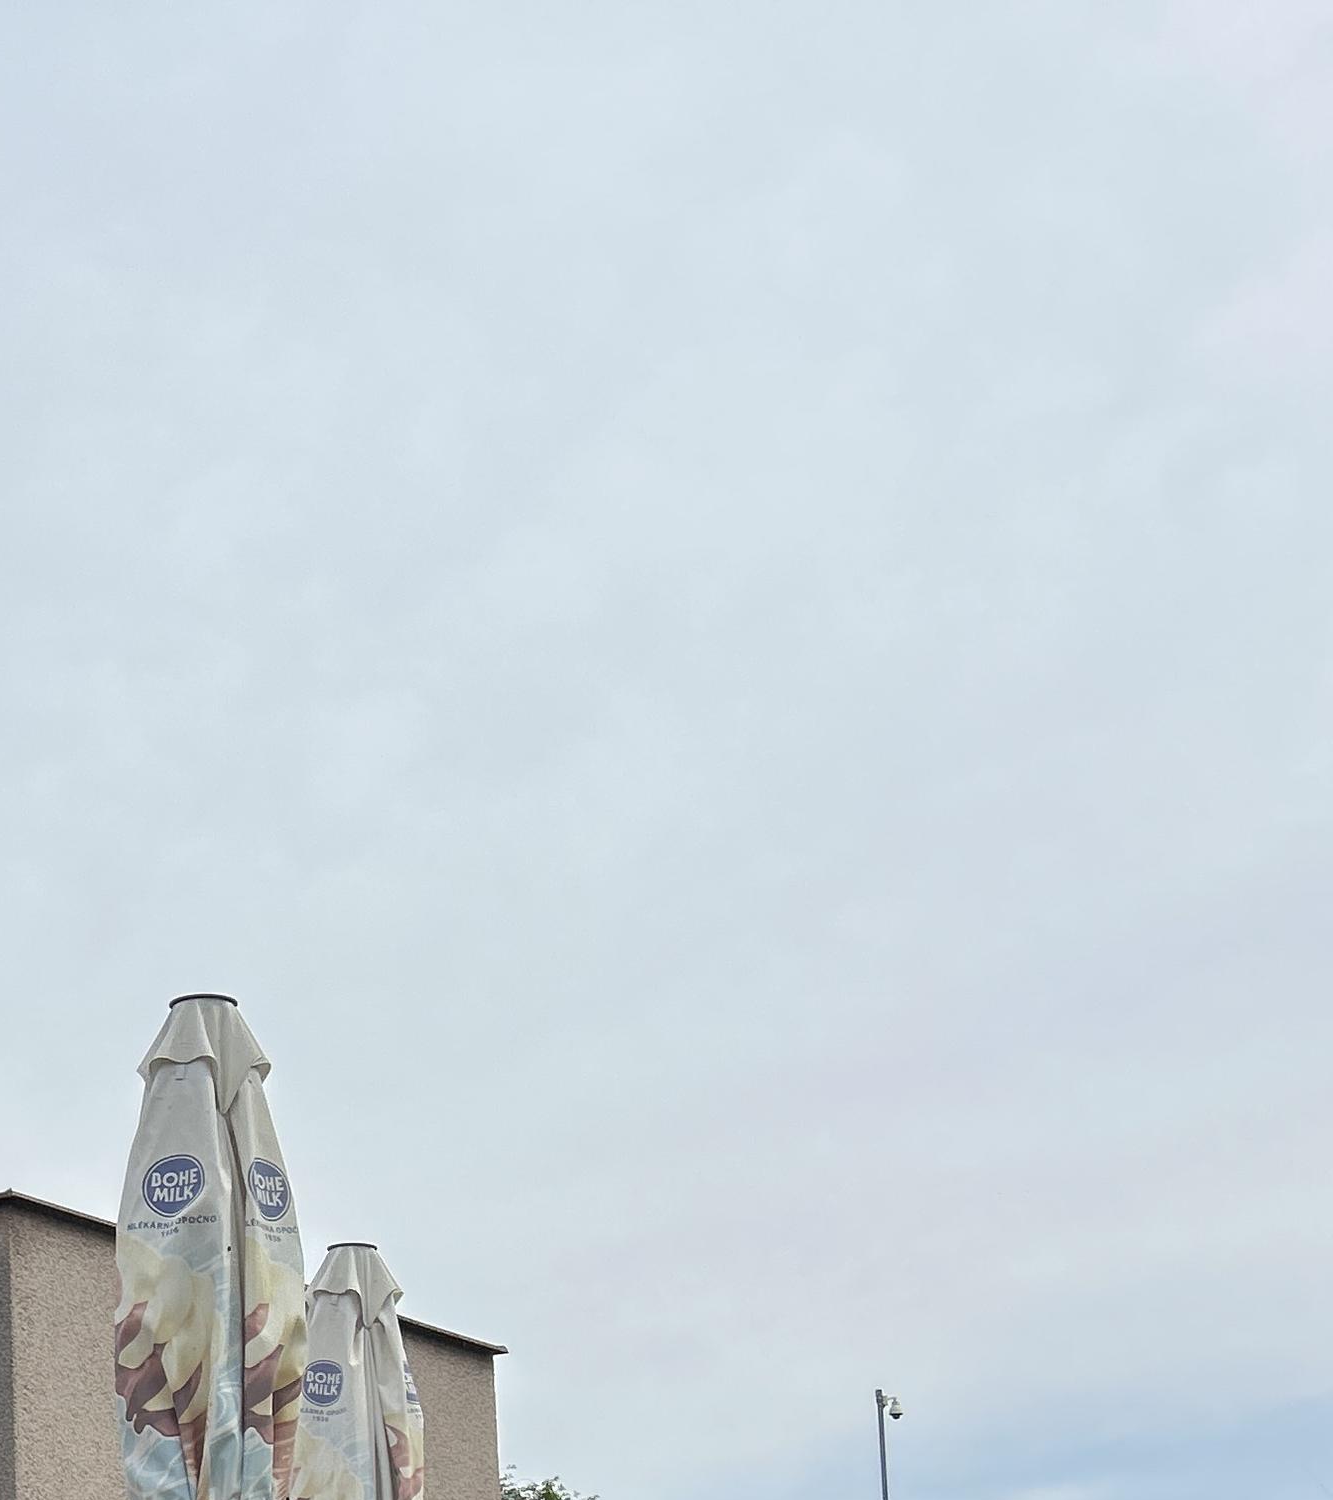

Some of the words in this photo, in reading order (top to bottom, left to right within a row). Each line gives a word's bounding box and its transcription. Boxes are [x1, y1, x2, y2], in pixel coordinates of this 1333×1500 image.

[151, 1167, 199, 1187] BOHE
[153, 1184, 194, 1203] MILK
[306, 1370, 342, 1384] BOHE
[306, 1382, 339, 1396] MILK
